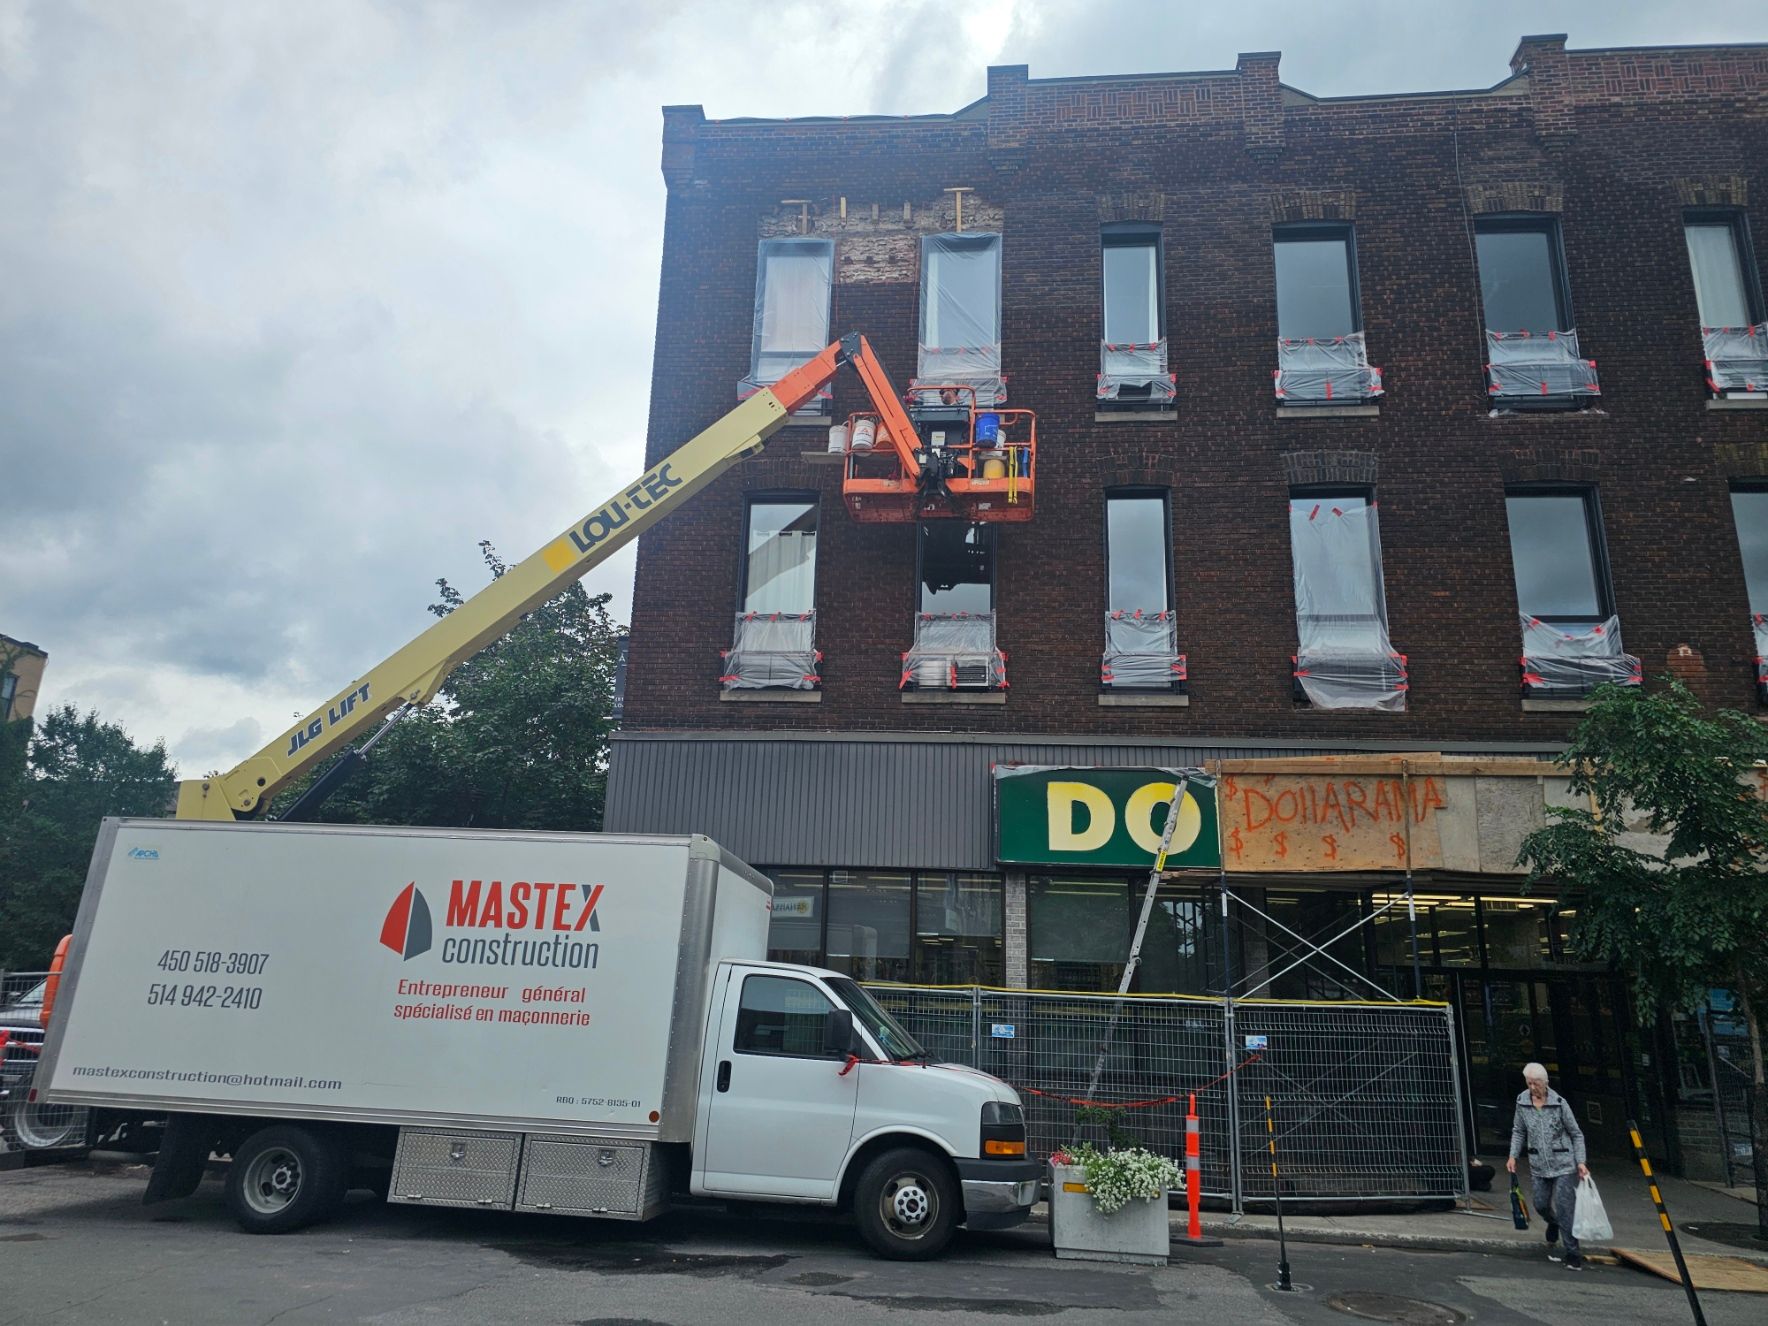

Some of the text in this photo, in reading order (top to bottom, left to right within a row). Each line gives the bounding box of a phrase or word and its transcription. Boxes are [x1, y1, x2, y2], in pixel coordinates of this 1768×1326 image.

[569, 462, 683, 552] LOU-TEC
[286, 681, 371, 758] JLG LIFT
[1047, 781, 1202, 856] DO
[446, 880, 604, 932] MASTEX
[157, 950, 269, 975] 450 518-3907
[442, 932, 600, 969] construction
[147, 983, 263, 1010] 514 942-2410
[397, 979, 586, 1004] Entrepreneur général
[394, 1002, 590, 1027] spécialisé en maçonnerie
[72, 1064, 342, 1090] mastexconstruction@hotmail.com
